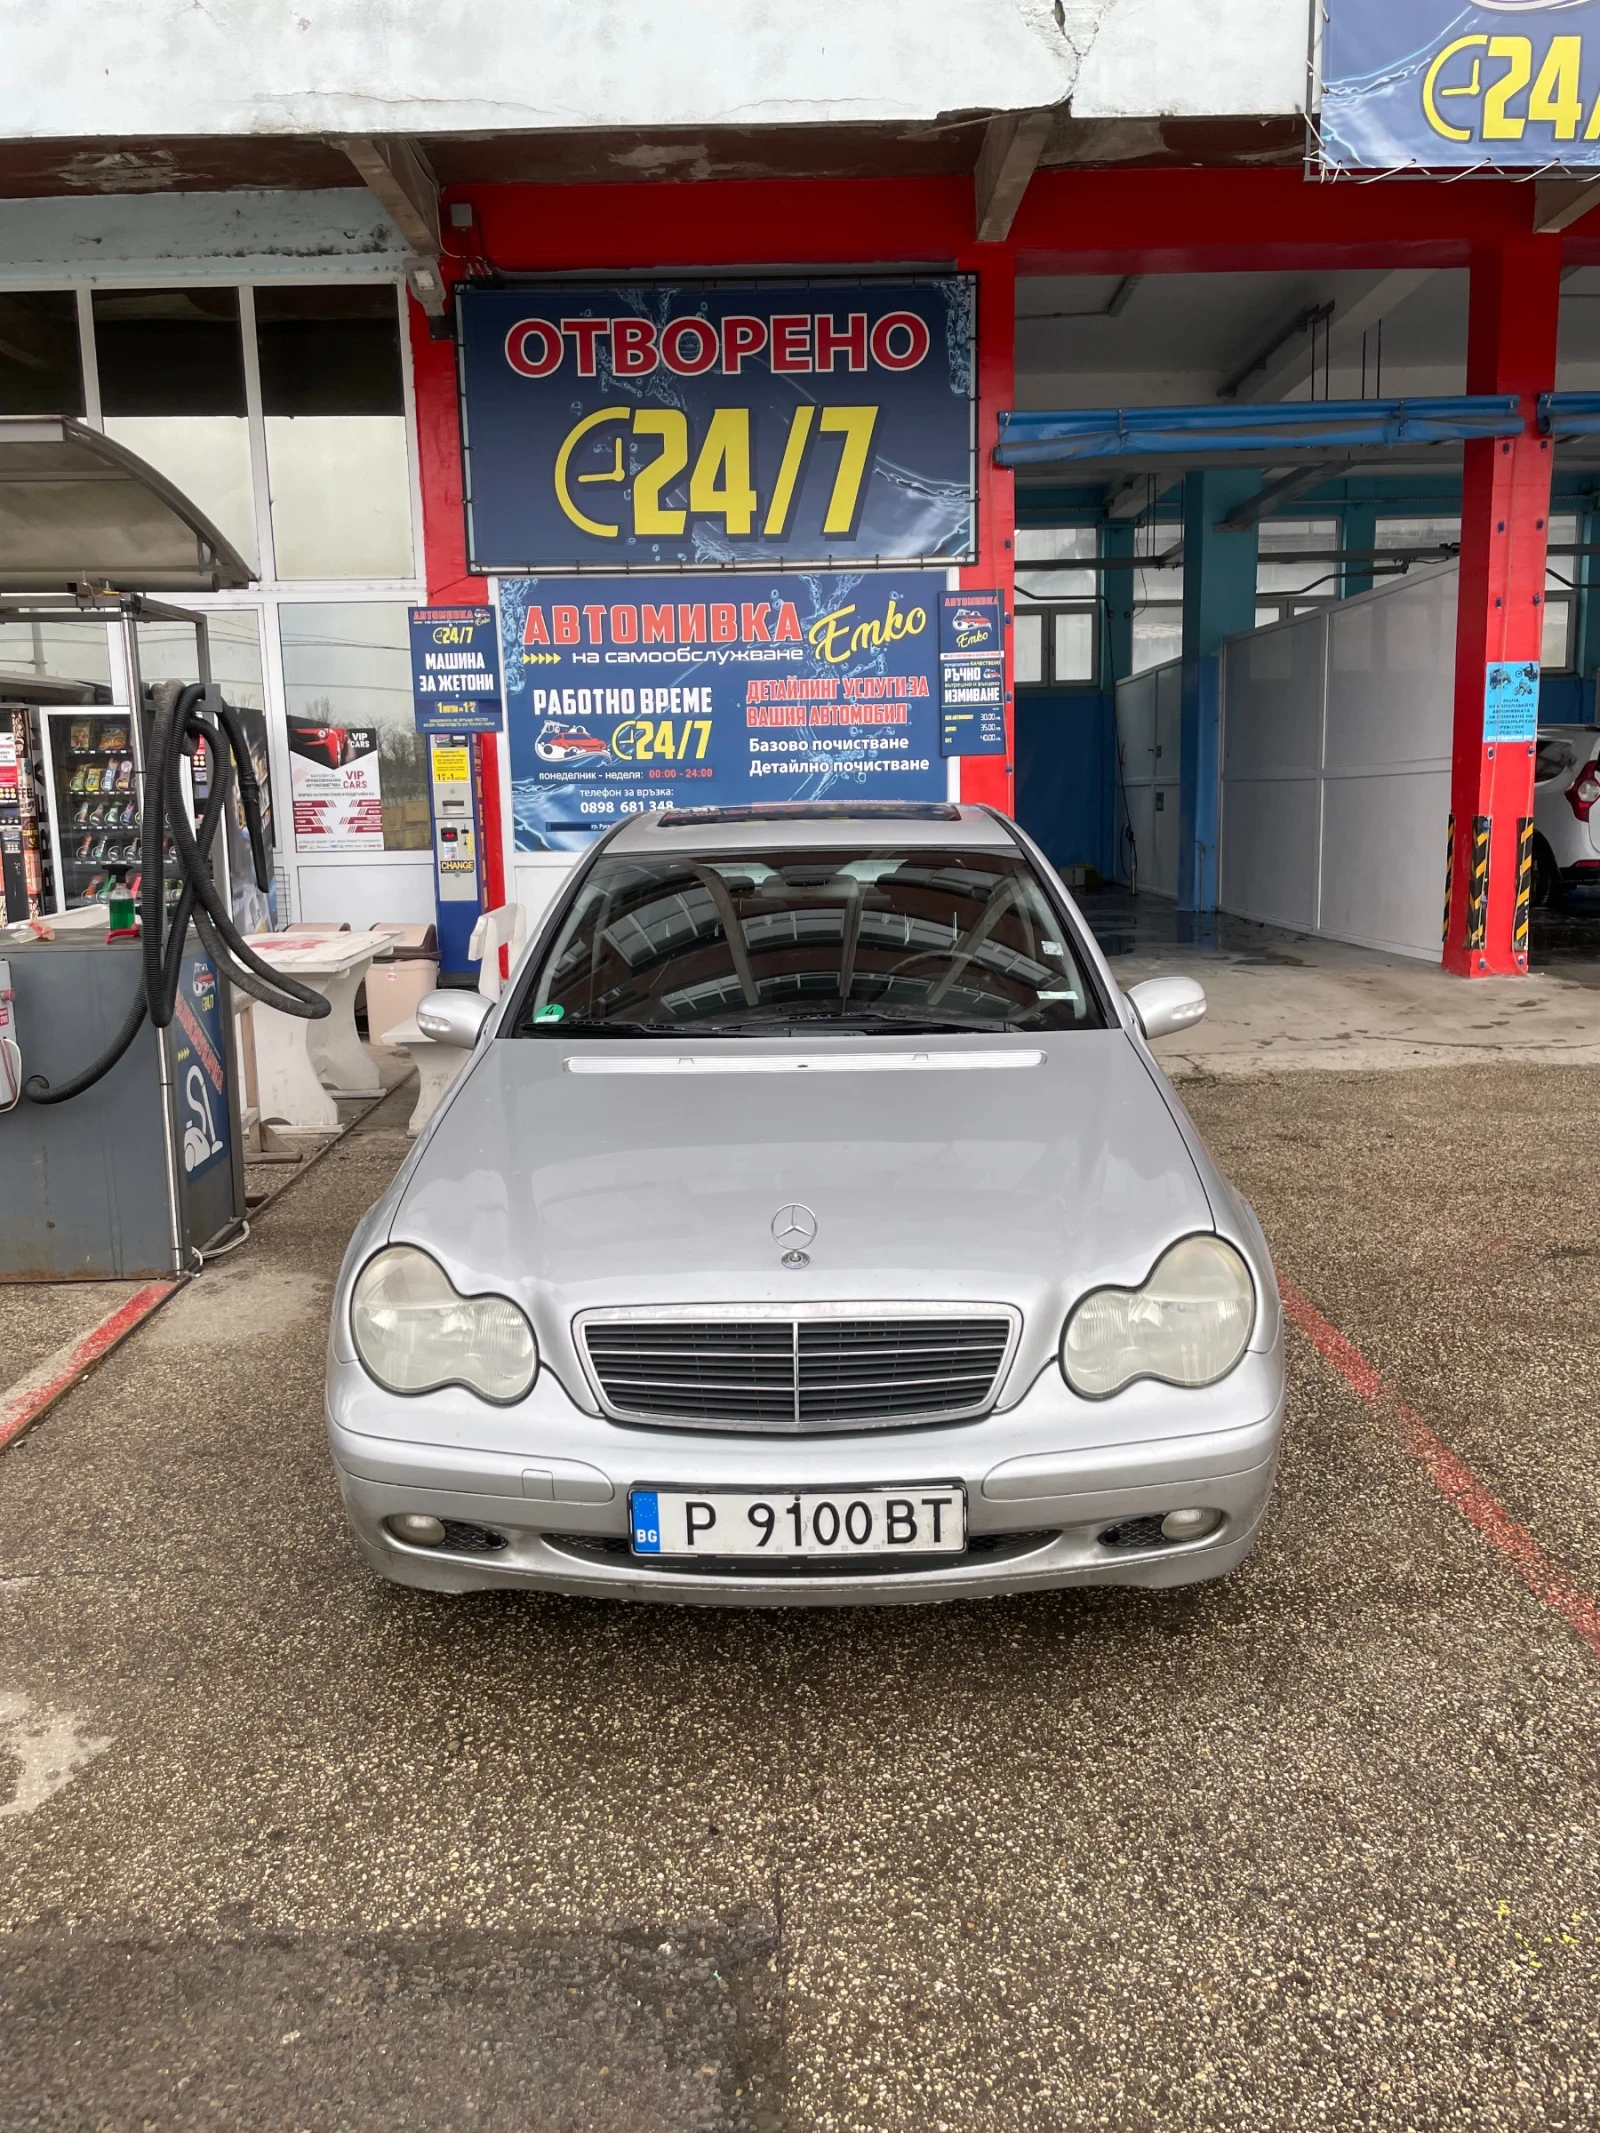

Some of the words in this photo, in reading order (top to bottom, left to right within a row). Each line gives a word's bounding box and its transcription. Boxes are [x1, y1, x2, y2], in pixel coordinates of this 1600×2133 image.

[1482, 35, 1600, 140] 24
[504, 310, 931, 379] ОТВОРЕНО
[632, 405, 879, 535] 24/7
[523, 602, 804, 646] АВТОМИВКА
[442, 626, 474, 644] 24/7
[425, 652, 486, 670] МАШИНА
[572, 651, 600, 664] на
[605, 647, 804, 666] самообслужване
[419, 675, 437, 692] ЗА
[438, 673, 494, 691] ЖЕТОНИ
[944, 667, 981, 682] РЪЧНО
[746, 675, 840, 704] ДЕТАЙЛИНГ
[843, 677, 907, 700] УСЛУГИ
[906, 676, 930, 698] ЗА
[944, 687, 1000, 703] ИЗМИВАНЕ
[533, 688, 638, 715] РАБОТНО
[640, 687, 713, 713] ВРЕМЕ
[746, 705, 807, 727] ВАШИЯ
[808, 703, 908, 726] АВТОМОБИЛ
[350, 740, 371, 748] CARS
[351, 732, 369, 741] VIP
[634, 720, 713, 760] 24/7
[749, 737, 809, 752] Базово
[812, 737, 909, 750] почистване
[345, 770, 365, 780] VIP
[539, 771, 597, 781] понеделник
[605, 770, 644, 781] неделя:
[649, 769, 677, 779] 00:00
[685, 768, 713, 778] 24:00
[749, 760, 830, 776] Детайлно
[833, 759, 930, 773] почистване
[343, 780, 368, 789] CARS
[580, 788, 621, 798] телефон
[623, 789, 635, 797] за
[636, 787, 674, 798] връзка:
[580, 801, 615, 813] 0898
[620, 801, 645, 813] 681
[649, 800, 675, 811] 348
[441, 861, 475, 871] CHANGE
[544, 1005, 554, 1015] 4
[636, 1529, 658, 1543] BG
